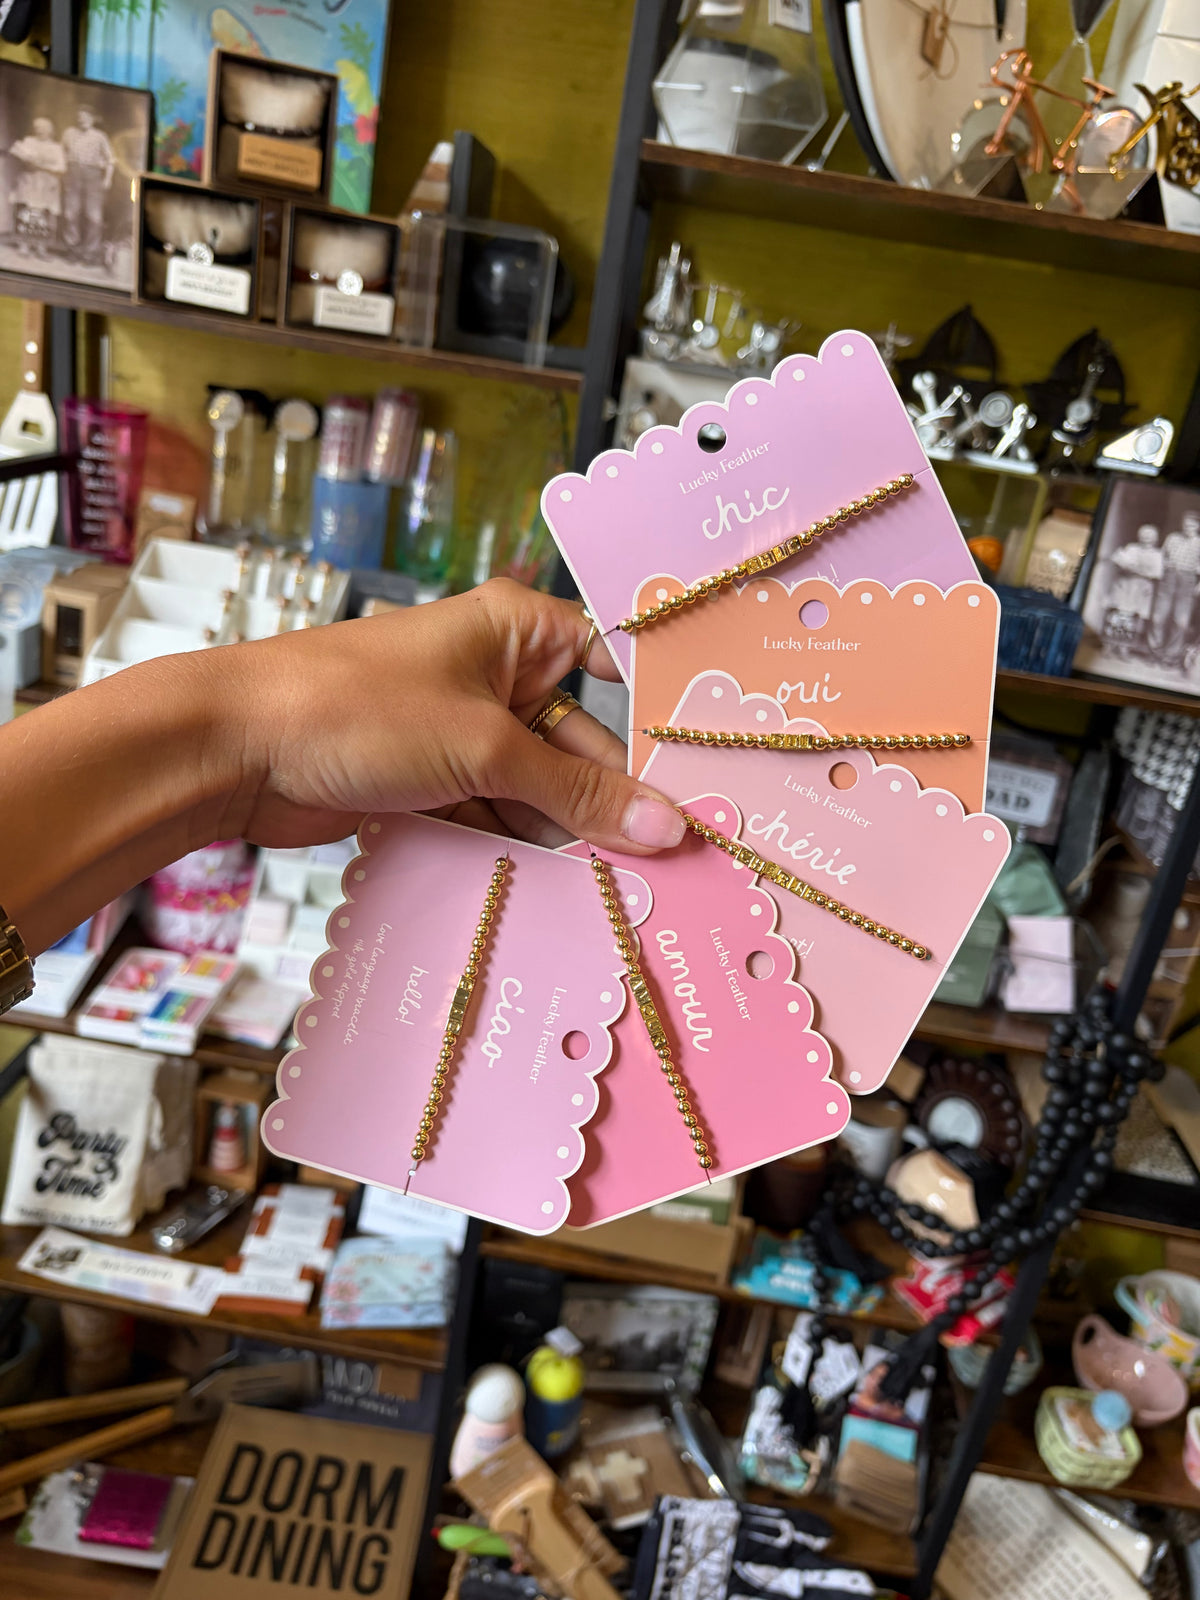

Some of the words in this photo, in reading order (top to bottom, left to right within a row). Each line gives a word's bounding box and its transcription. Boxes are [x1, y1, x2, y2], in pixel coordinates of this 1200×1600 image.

[679, 469, 719, 494] Lucky
[719, 441, 771, 474] Feather
[701, 487, 790, 540] chic
[763, 636, 805, 652] Lucky
[807, 637, 861, 651] Feather
[776, 672, 841, 704] oui
[783, 774, 821, 804] Lucky
[822, 795, 873, 829] Feather
[746, 809, 857, 885] chérie
[376, 922, 393, 944] love
[343, 953, 357, 980] gold
[357, 947, 385, 995] language
[655, 929, 713, 1052] amour
[709, 927, 731, 967] Lucky
[725, 969, 751, 1021] Feather
[331, 982, 350, 1019] dipped
[343, 996, 366, 1045] bracelet
[394, 965, 430, 1025] hello!
[543, 986, 568, 1028] Lucky
[480, 977, 526, 1068] ciao
[529, 1030, 555, 1084] Feather
[38, 1111, 128, 1182] Party
[35, 1155, 106, 1198] Time
[216, 1442, 406, 1530] DORM
[191, 1508, 390, 1596] DINING
